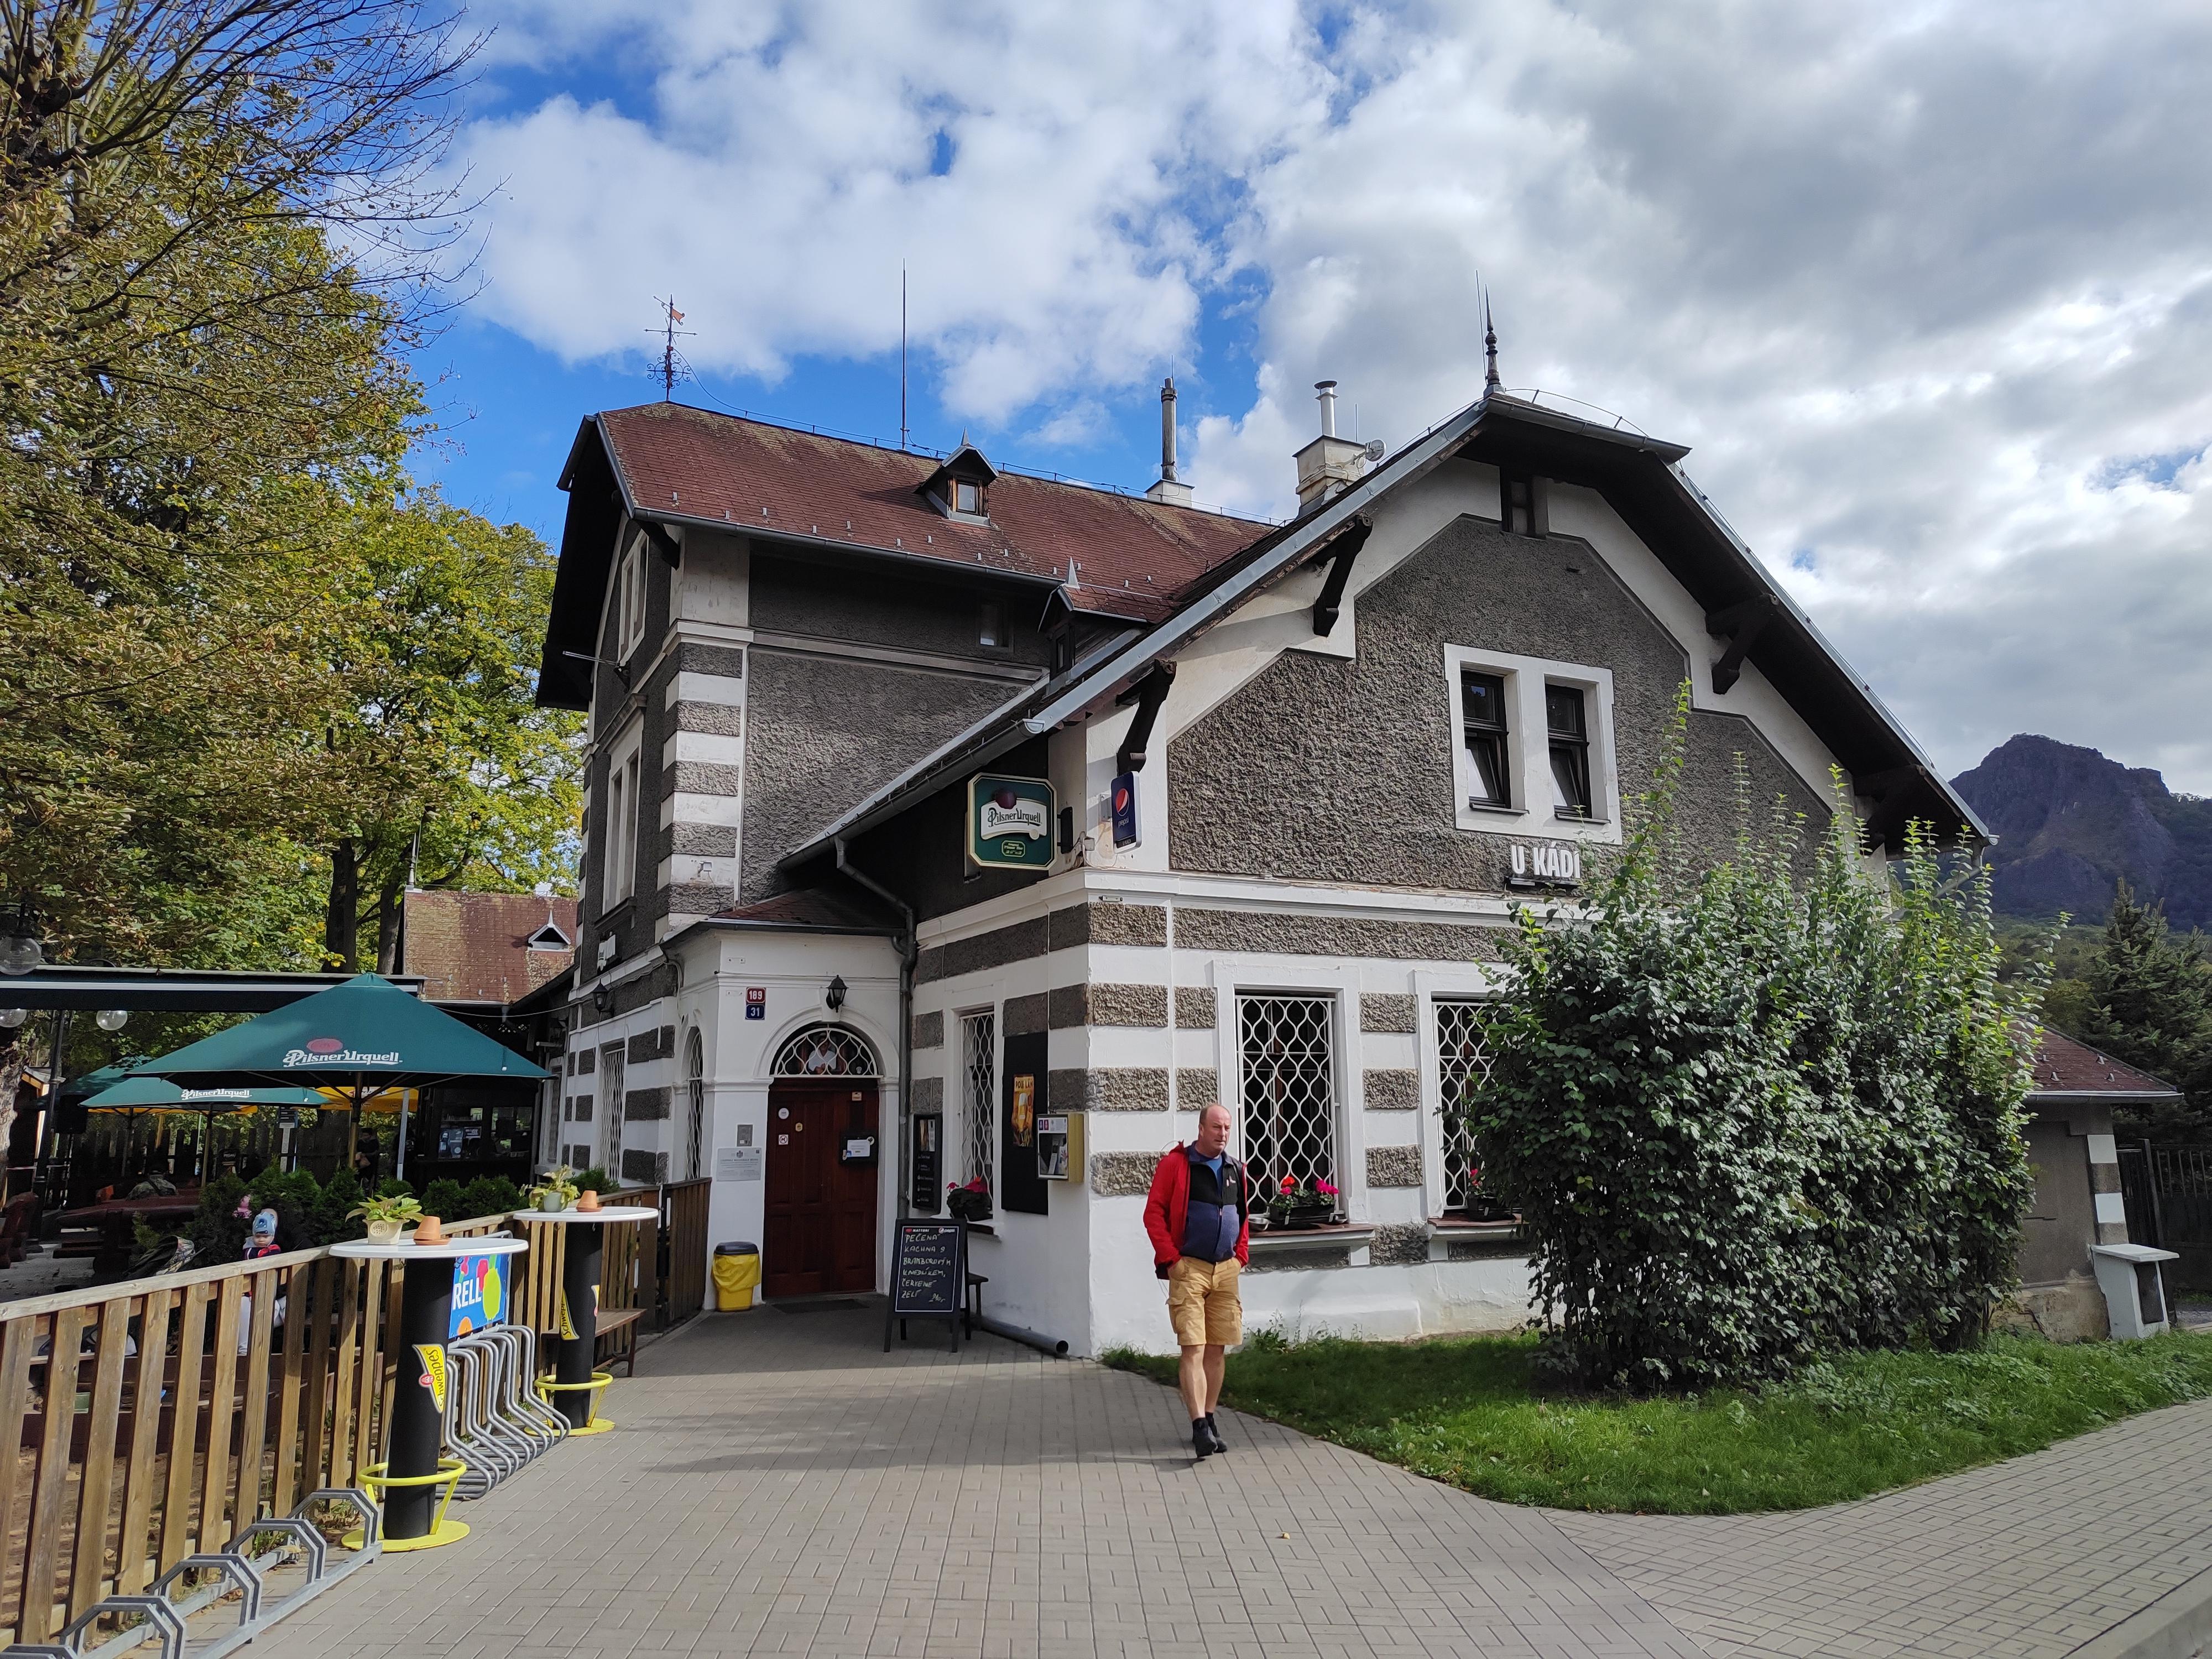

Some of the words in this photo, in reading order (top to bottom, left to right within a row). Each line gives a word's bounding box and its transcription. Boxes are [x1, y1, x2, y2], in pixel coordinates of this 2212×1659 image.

[987, 807, 1016, 827] Pilsner
[1016, 808, 1041, 826] Urquell
[1118, 816, 1129, 828] pepsi
[1510, 844, 1526, 875] U
[1532, 841, 1581, 879] KÁDI
[749, 990, 763, 1000] 189
[750, 1006, 760, 1017] 31
[283, 1049, 345, 1068] Pilsner
[343, 1049, 399, 1065] Urquell
[181, 1089, 218, 1100] Pilsner
[216, 1088, 250, 1098] Urquell
[452, 1277, 482, 1310] RELL
[425, 1348, 445, 1407] Schweppes
